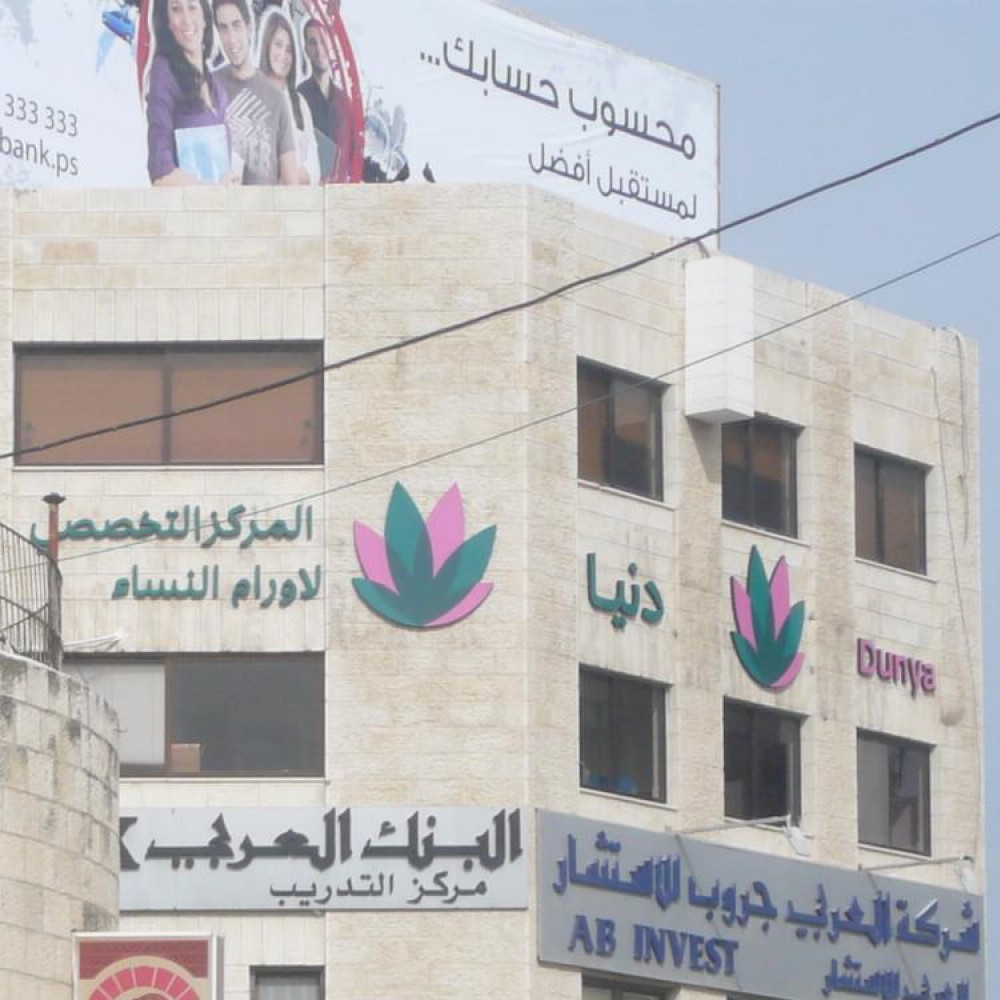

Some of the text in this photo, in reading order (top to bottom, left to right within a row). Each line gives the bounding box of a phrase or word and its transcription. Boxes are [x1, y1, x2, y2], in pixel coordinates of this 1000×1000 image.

[4, 93, 39, 125] 333
[44, 106, 78, 137] 333
[568, 87, 697, 161] محسوب
[528, 142, 697, 220] لمستقبل أفضل
[200, 503, 314, 549] المركز
[586, 552, 665, 632] دنيا
[856, 638, 937, 700] Dunya
[144, 808, 352, 871] العربي
[360, 807, 523, 871] البنك
[269, 872, 488, 906] مركز التدريب
[687, 875, 778, 934] جروب
[785, 883, 891, 948] العربي
[567, 914, 739, 977] AB INVEST
[896, 898, 980, 962] شركة
